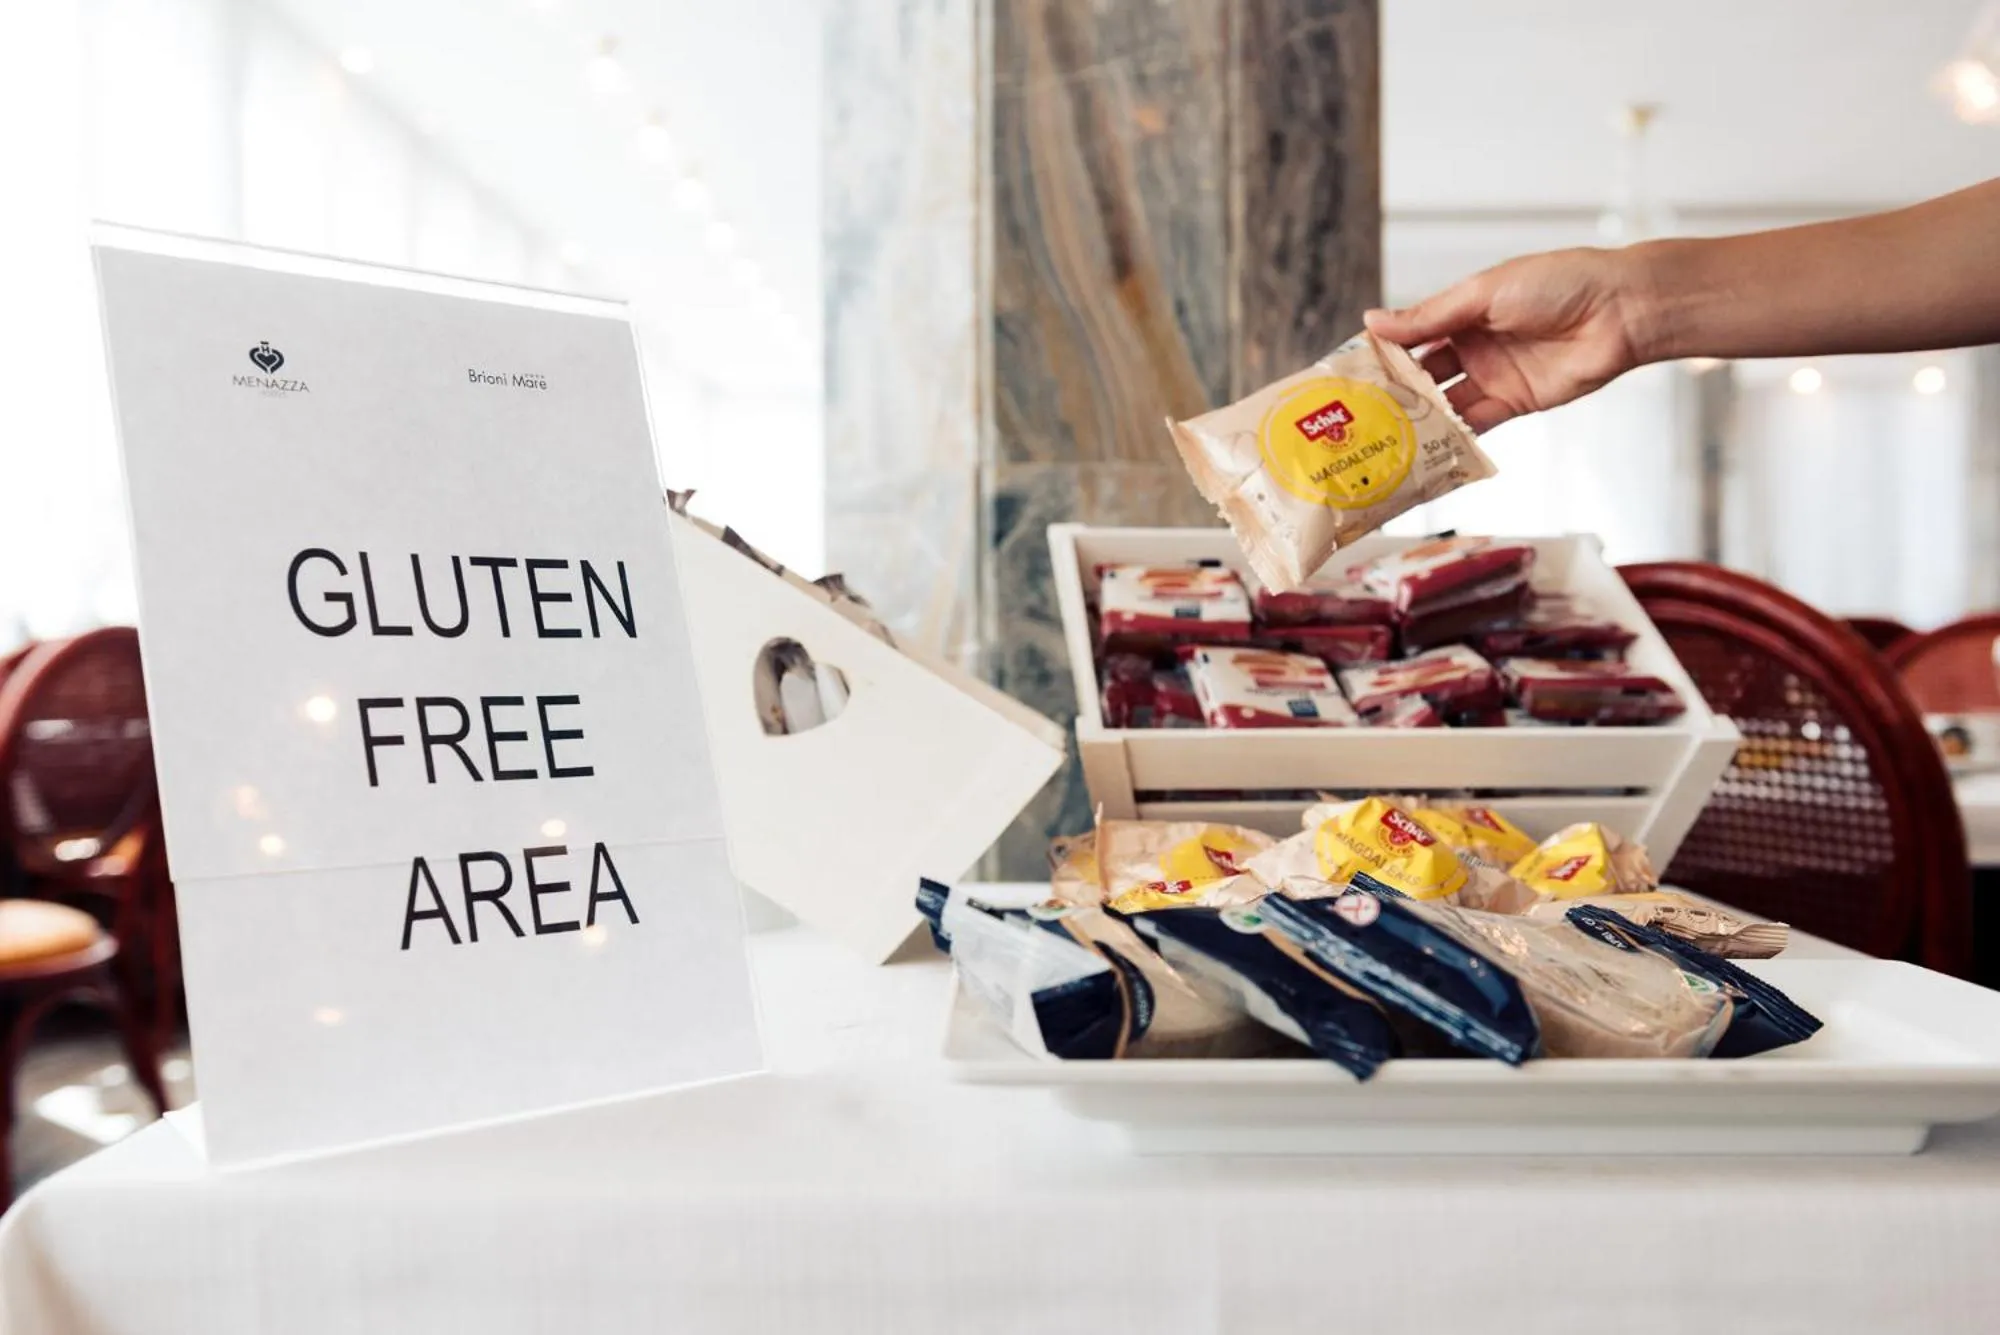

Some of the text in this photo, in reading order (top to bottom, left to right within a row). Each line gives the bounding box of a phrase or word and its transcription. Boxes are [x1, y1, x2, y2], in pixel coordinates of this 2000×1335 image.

[232, 374, 310, 393] MENAZZA
[468, 368, 547, 390] Brioni Mare
[1310, 435, 1398, 485] MAGDALENAS
[288, 548, 638, 639] GLUTEN
[357, 694, 595, 787] FREE
[401, 842, 640, 951] AREA
